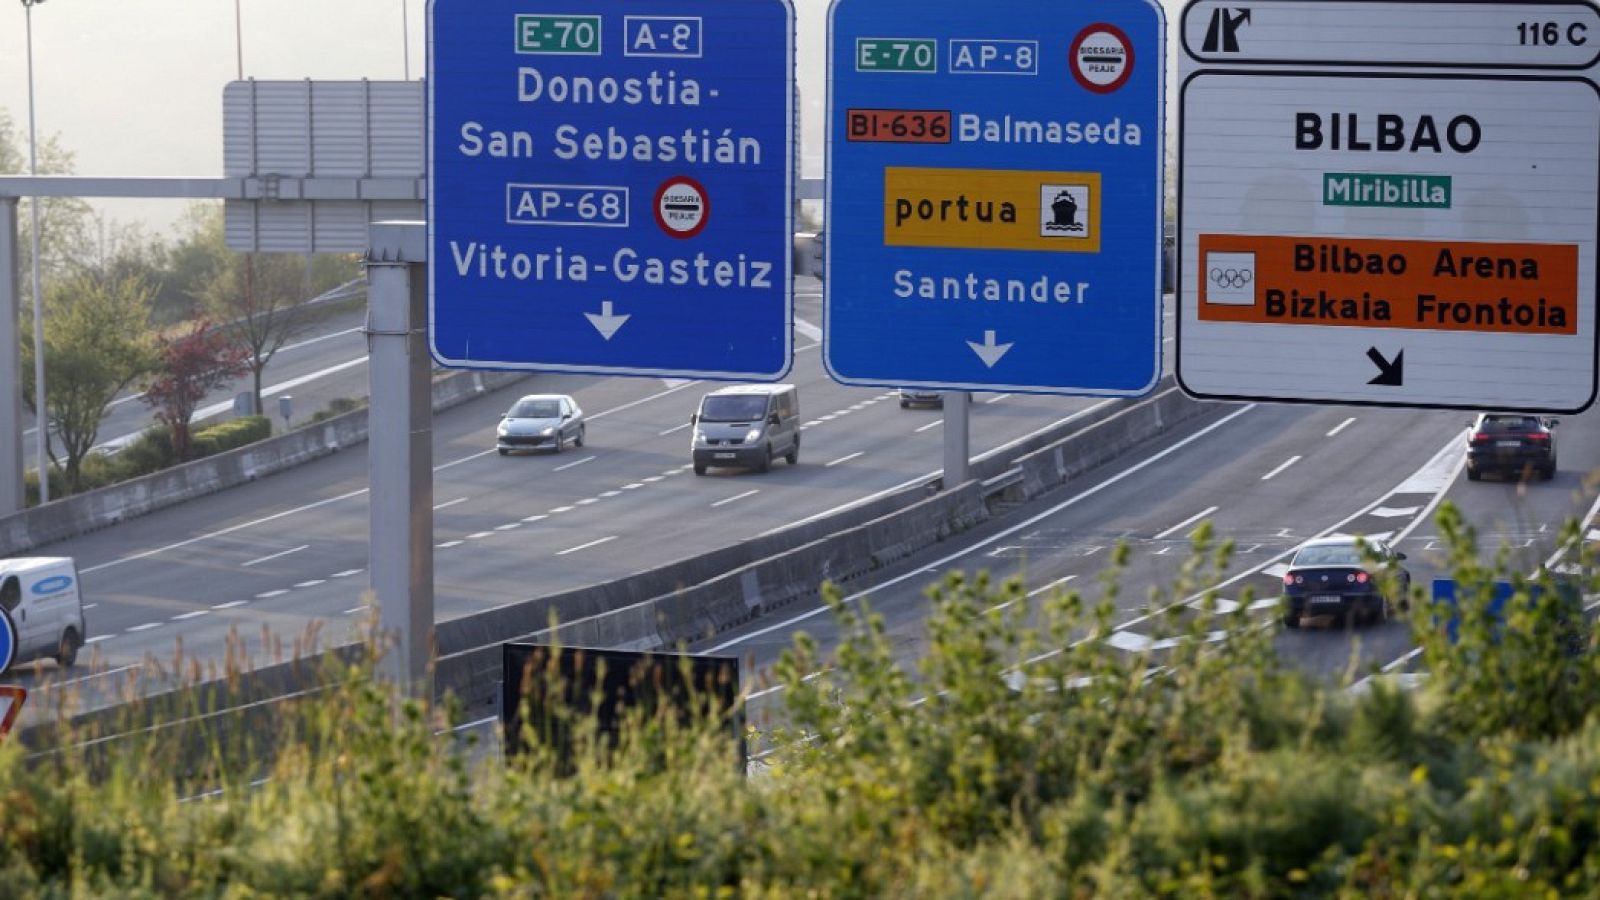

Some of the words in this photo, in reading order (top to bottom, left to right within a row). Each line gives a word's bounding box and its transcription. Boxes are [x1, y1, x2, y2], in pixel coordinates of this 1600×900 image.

[523, 21, 594, 48] E-70
[634, 23, 690, 51] A-8
[1517, 22, 1559, 46] 116
[1567, 23, 1587, 46] C
[861, 44, 931, 66] E-70
[955, 46, 1032, 68] AP-8
[459, 121, 532, 157] San
[554, 125, 760, 164] Sebastián
[851, 115, 946, 138] BI-636
[959, 114, 1141, 145] Balmaseda
[1296, 113, 1481, 153] BILBAO
[516, 191, 620, 220] AP-68
[1327, 178, 1446, 203] Miribilla
[896, 195, 1016, 227] portua
[450, 241, 771, 288] Vitoria-Gasteiz
[1295, 245, 1407, 275] Bilbao
[1433, 248, 1538, 280] Arena
[894, 269, 1089, 303] Santander
[1266, 289, 1391, 320] Bizkaia
[1417, 294, 1567, 328] Frontoia
